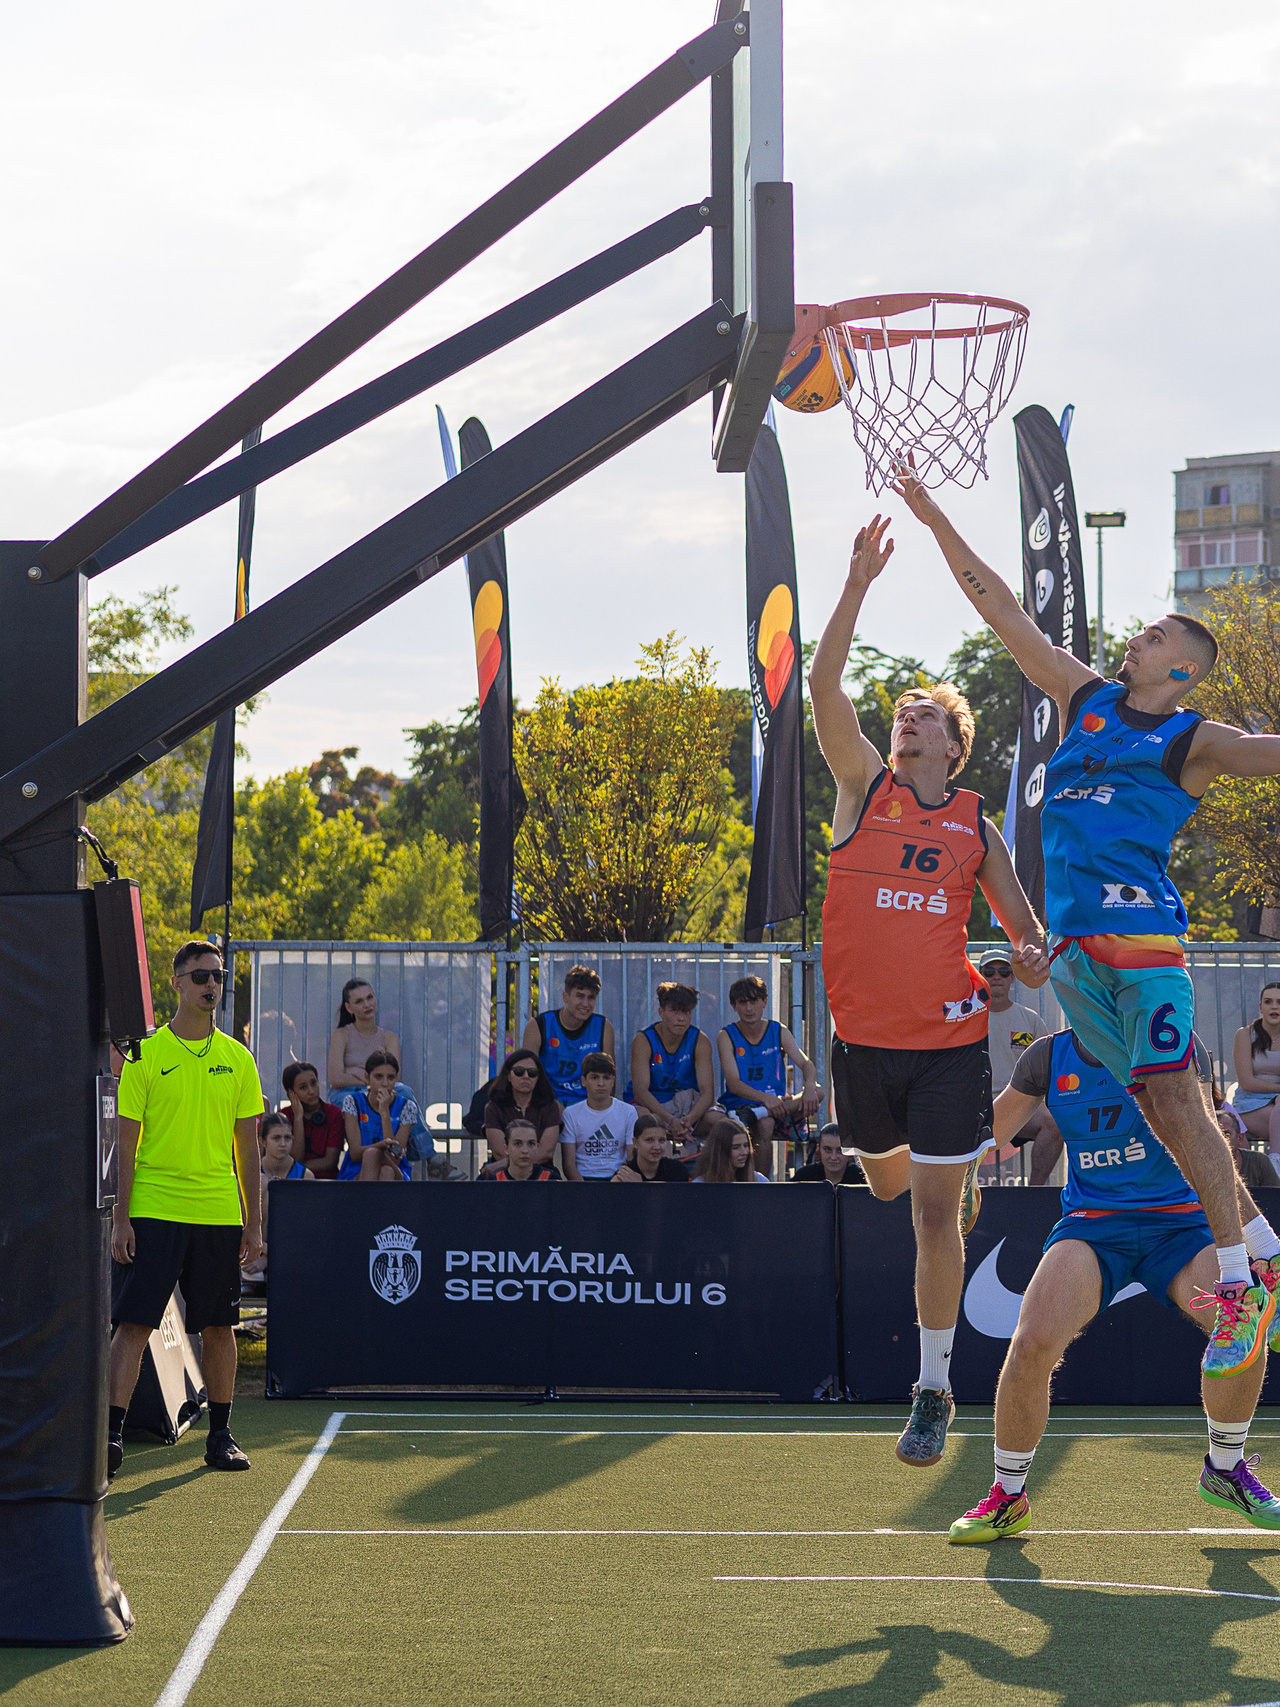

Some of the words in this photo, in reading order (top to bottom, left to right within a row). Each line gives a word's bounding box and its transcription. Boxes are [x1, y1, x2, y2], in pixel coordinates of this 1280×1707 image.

[900, 843, 942, 873] 16
[876, 888, 925, 911] BCR
[1148, 1003, 1181, 1052] 6
[558, 1060, 578, 1075] 19
[747, 1068, 764, 1081] 13
[1088, 1104, 1123, 1133] 17
[585, 1139, 619, 1149] adidas
[1079, 1148, 1122, 1170] BCR
[446, 1246, 634, 1275] PRIMĂRIA
[445, 1278, 691, 1305] SECTORULUI
[702, 1283, 727, 1305] 6
